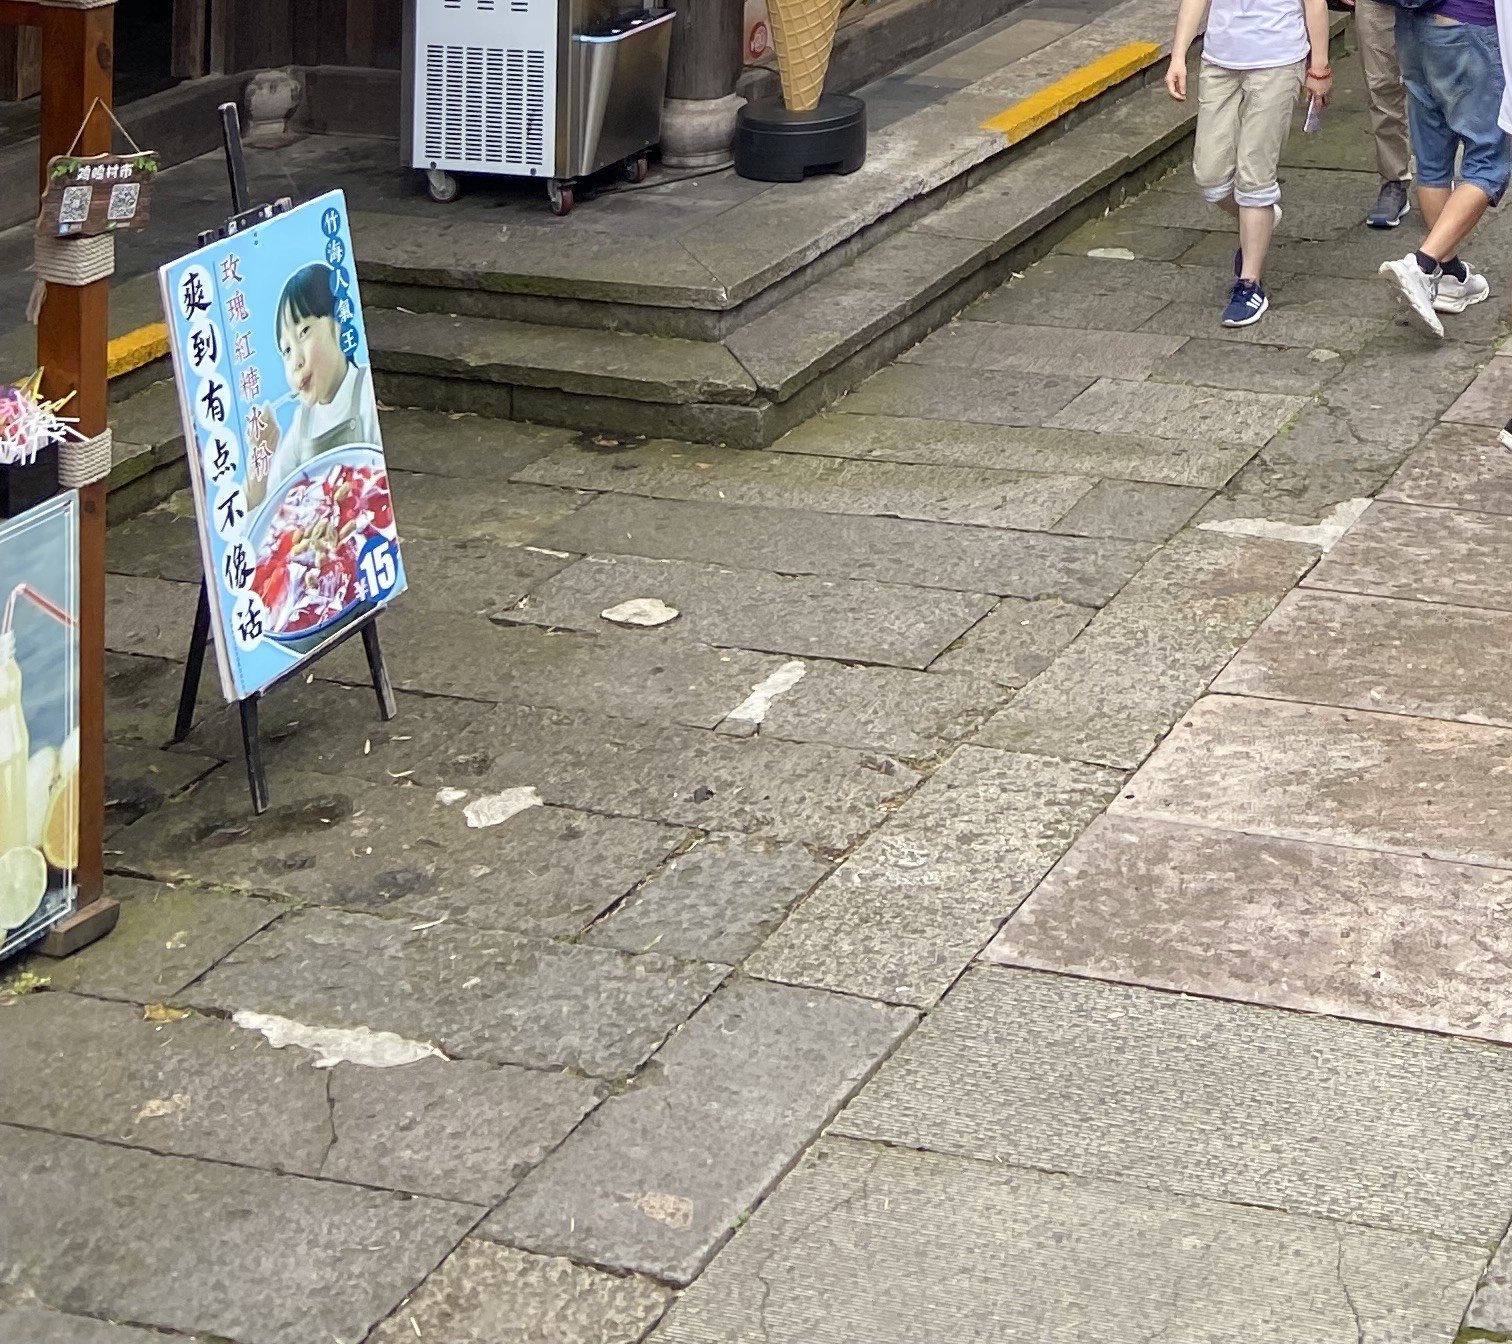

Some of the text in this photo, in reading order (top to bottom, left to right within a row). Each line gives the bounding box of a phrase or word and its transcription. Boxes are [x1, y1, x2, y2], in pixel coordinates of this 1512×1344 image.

[219, 253, 273, 484] 玫瑰紅糖冰粉
[324, 212, 358, 352] 竹海人氣王
[182, 270, 264, 642] 爽到有点不像话
